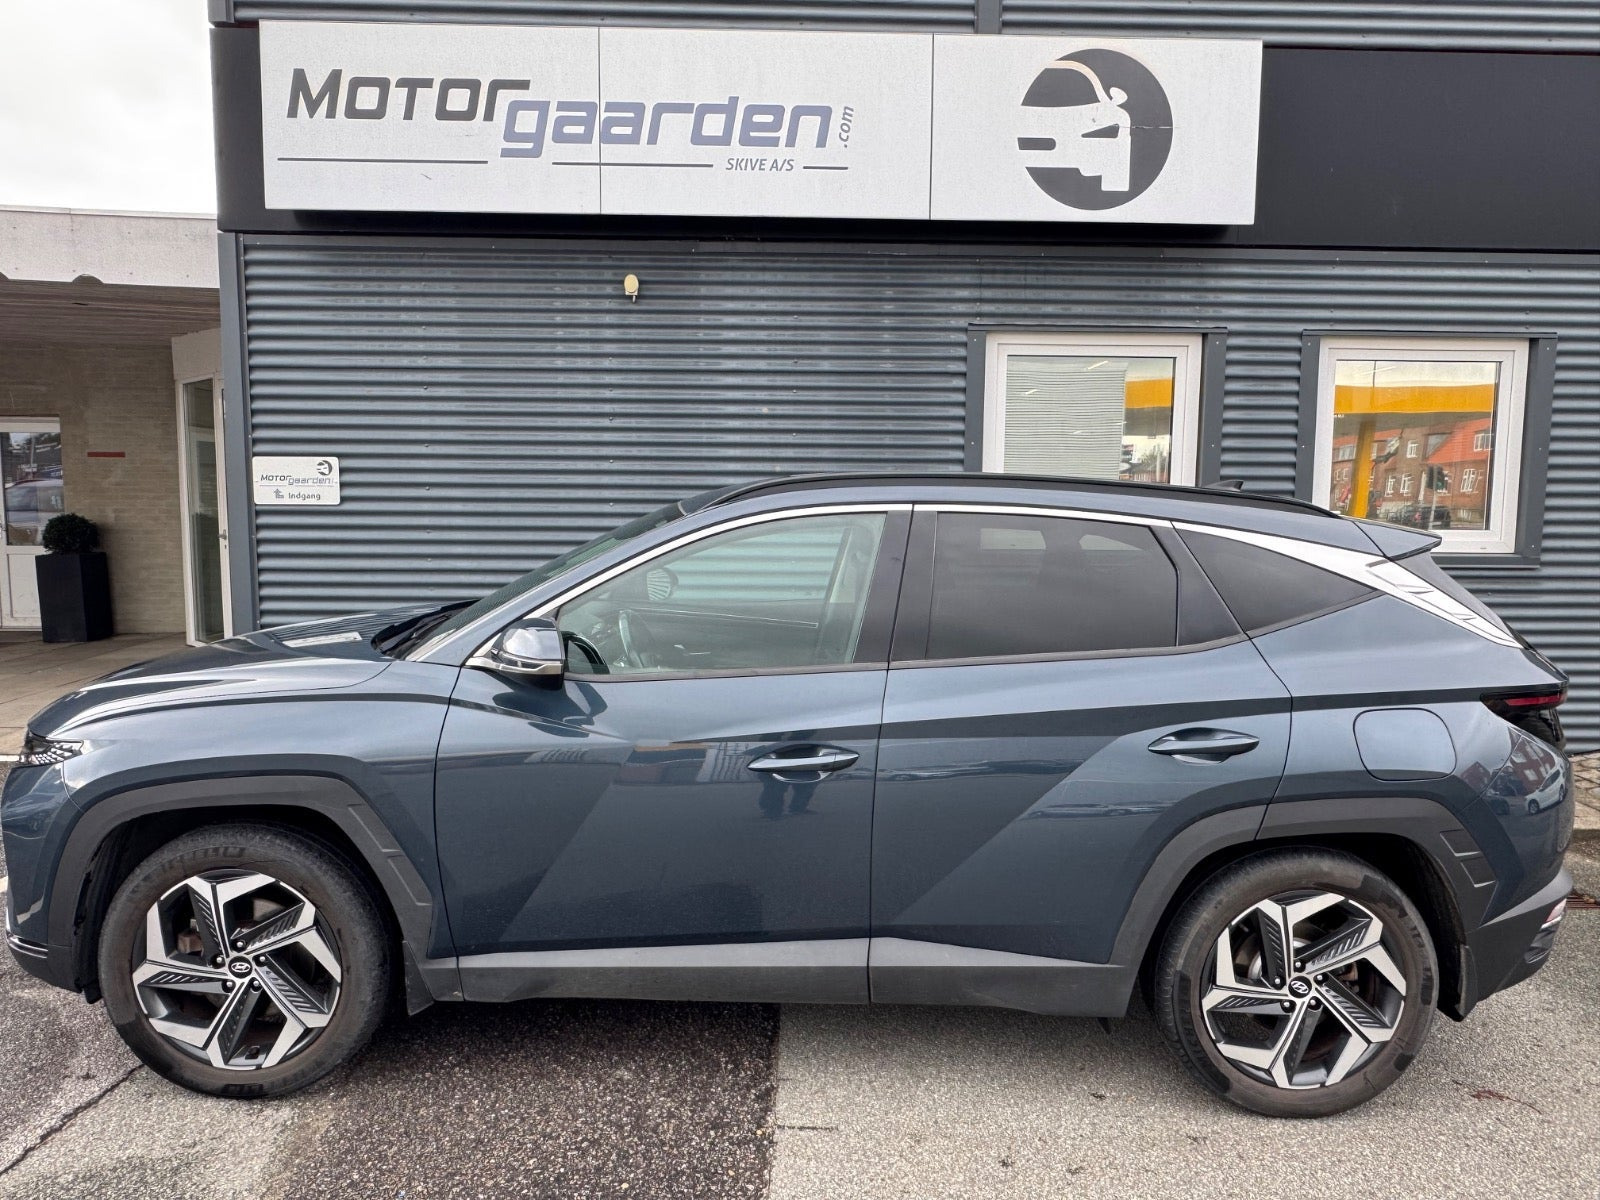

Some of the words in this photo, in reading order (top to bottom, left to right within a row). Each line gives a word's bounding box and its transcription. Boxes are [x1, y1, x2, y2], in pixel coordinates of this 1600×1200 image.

[725, 158, 767, 172] SKIVE
[769, 158, 795, 172] A/S
[288, 492, 321, 501] Indgang
